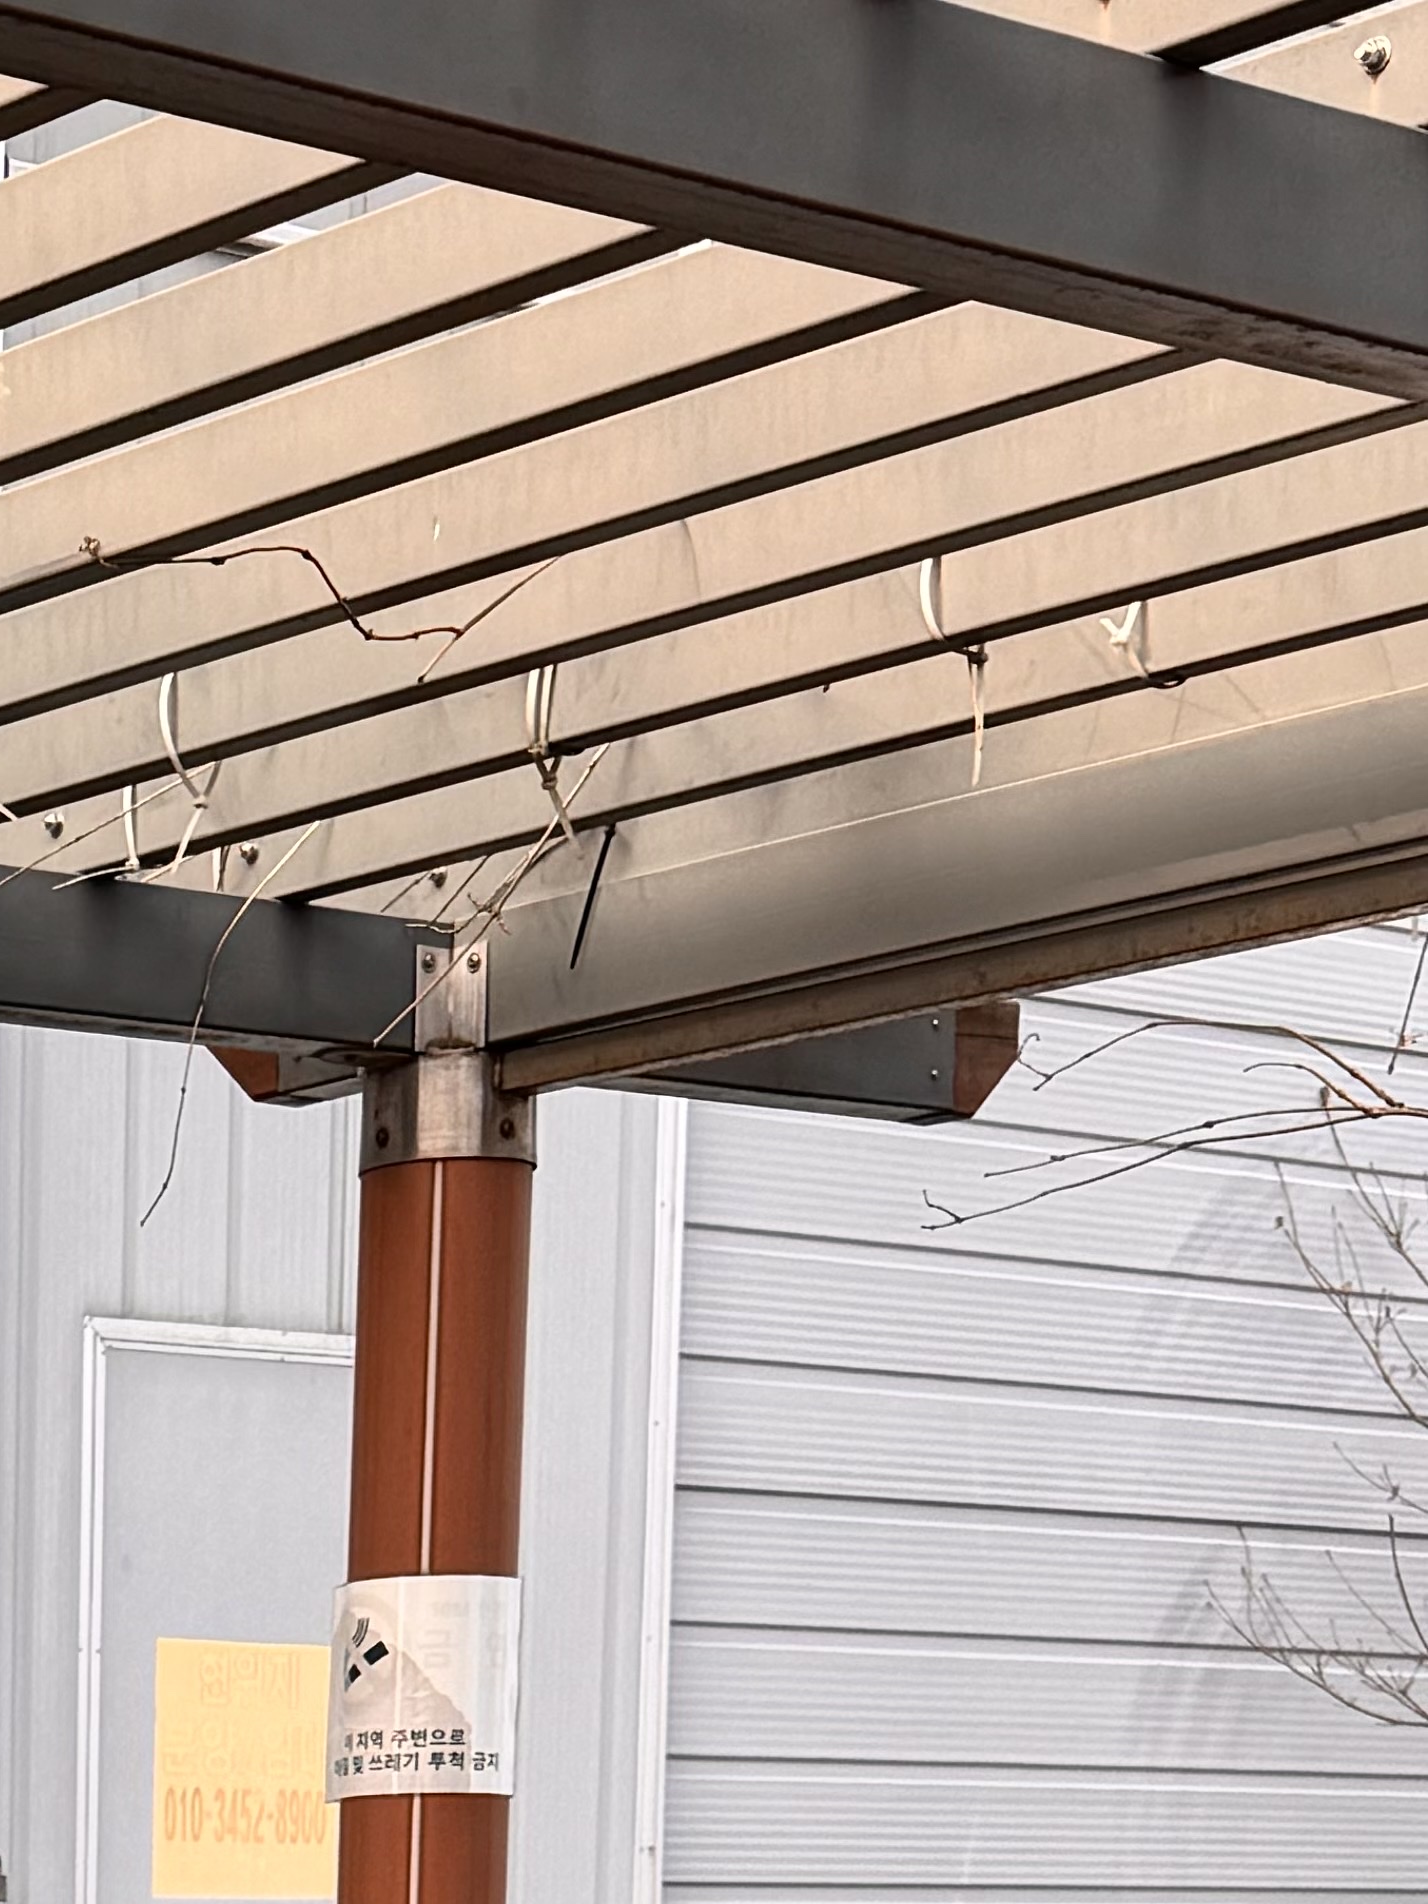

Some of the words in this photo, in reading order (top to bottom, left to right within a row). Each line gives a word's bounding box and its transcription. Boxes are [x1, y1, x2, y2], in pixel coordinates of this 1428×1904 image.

[356, 1730, 383, 1750] 지역
[391, 1728, 466, 1748] 주변으로
[368, 1752, 419, 1772] 쓰레기
[428, 1752, 465, 1771] 투척
[472, 1752, 499, 1772] 금지
